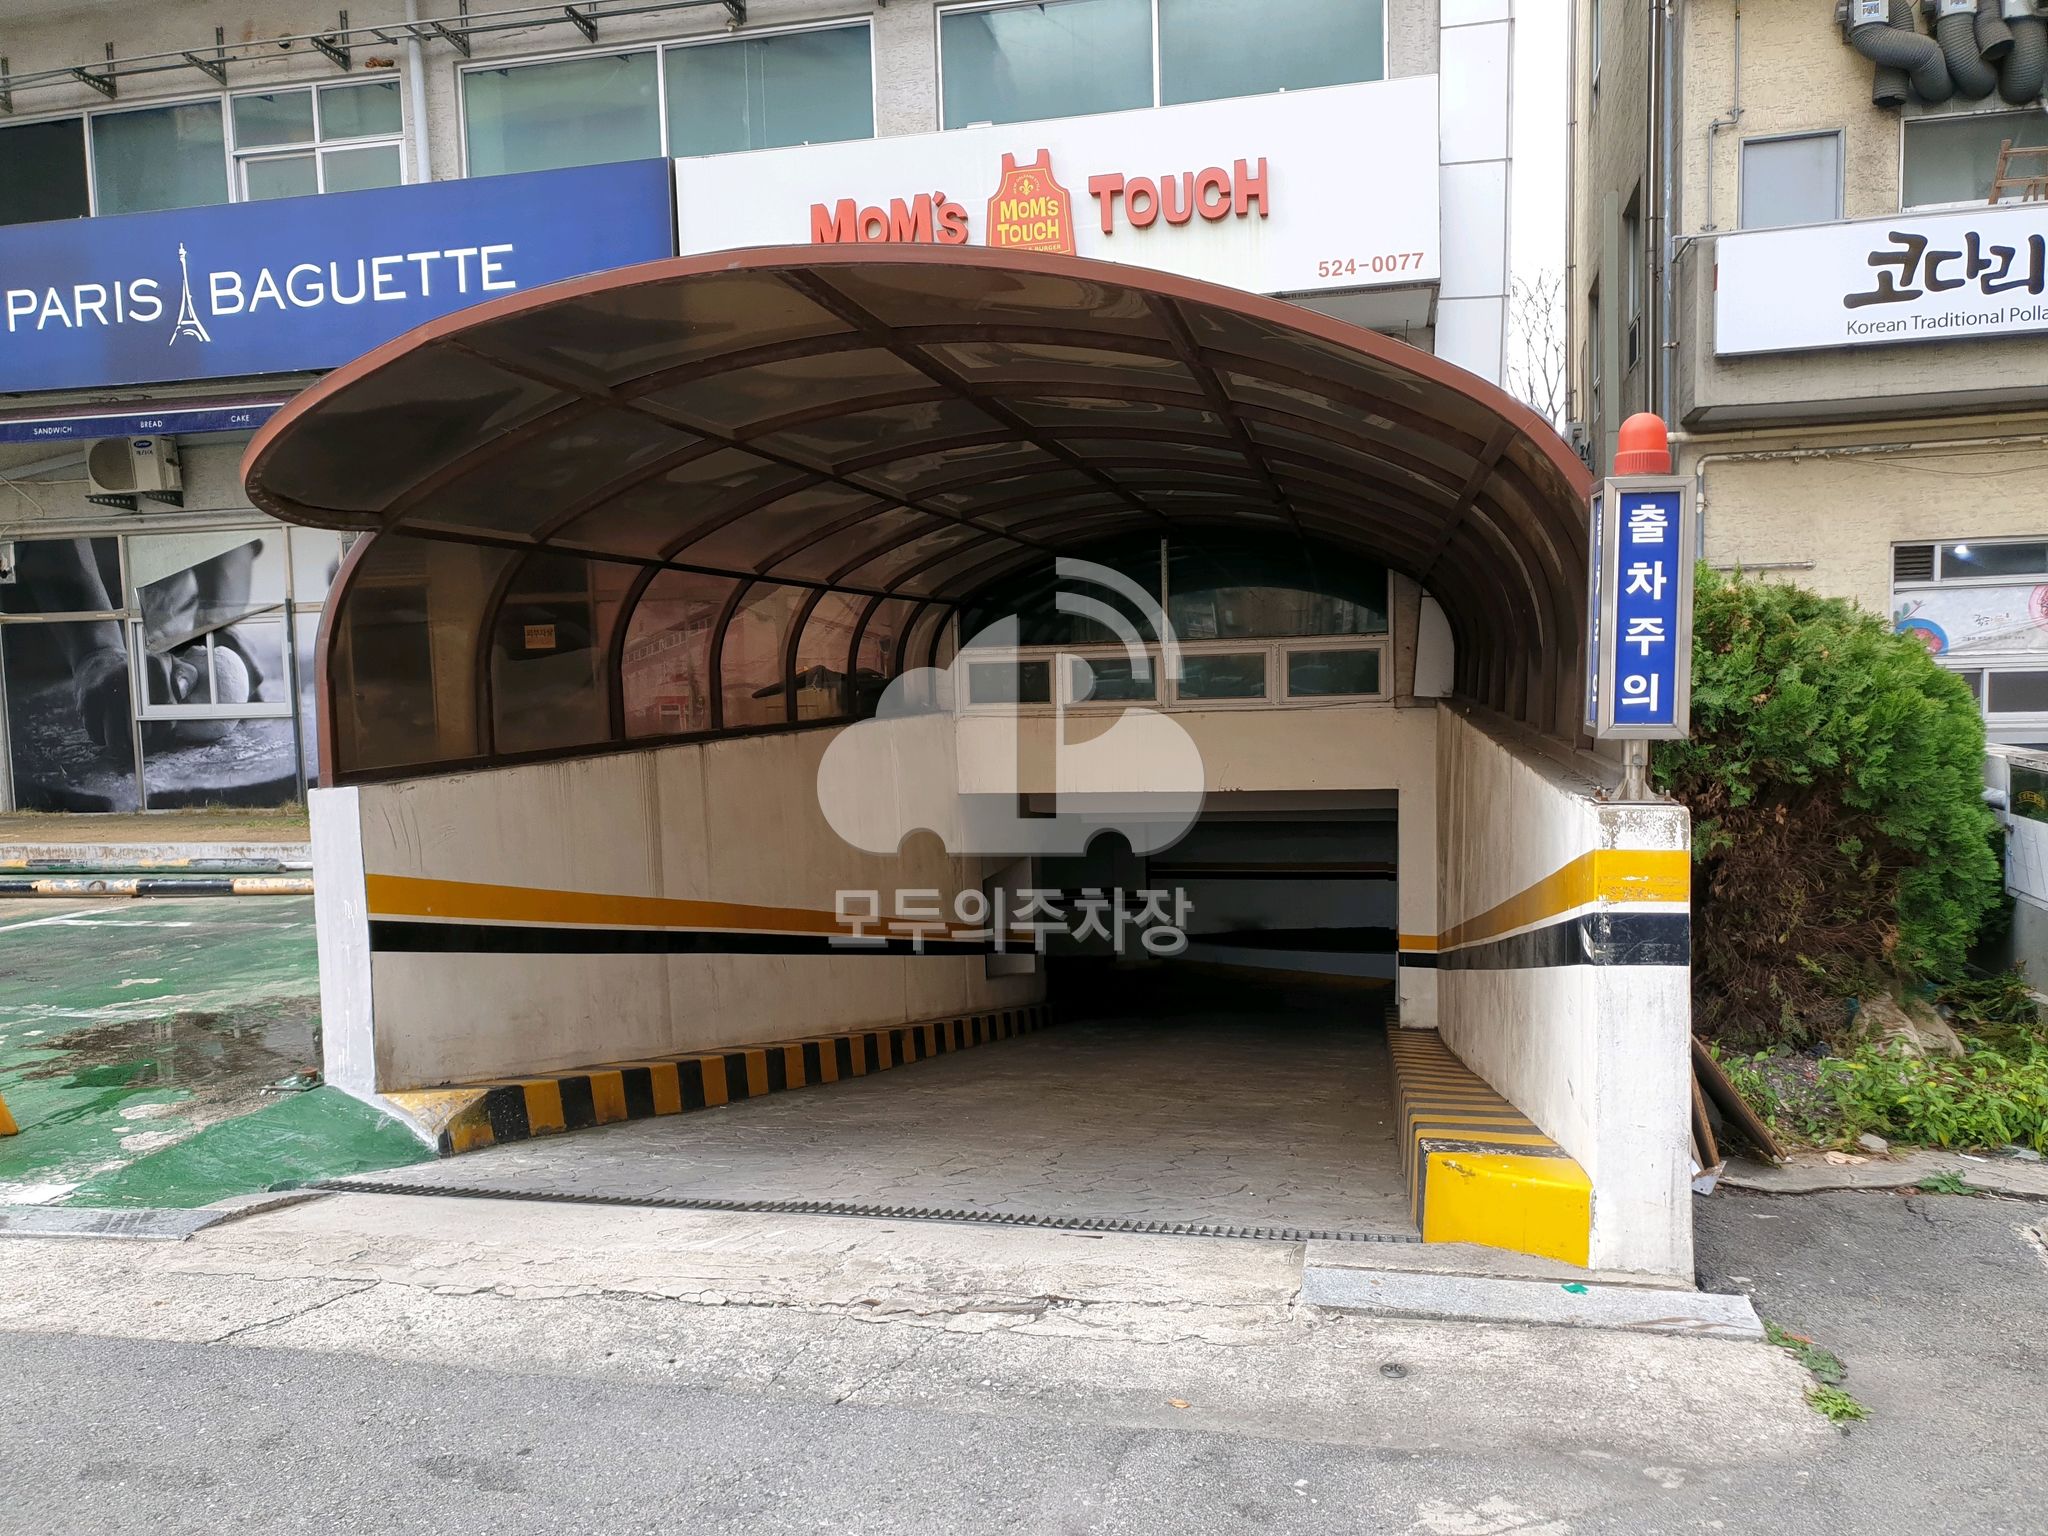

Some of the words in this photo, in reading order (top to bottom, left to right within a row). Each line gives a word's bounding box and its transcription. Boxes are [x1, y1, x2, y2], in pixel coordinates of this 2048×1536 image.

[1088, 157, 1268, 235] TOUCH
[997, 218, 1059, 245] TOUCH
[1318, 252, 1425, 278] 524-0077
[1843, 231, 2045, 309] 코다리
[7, 279, 163, 333] PARIS
[209, 243, 517, 317] BAGUETTE
[1846, 319, 1908, 336] Korean
[1911, 307, 2004, 331] Traditional
[33, 426, 72, 436] SANDWICH
[140, 420, 163, 429] BREAD
[231, 414, 250, 423] CAKE
[1621, 503, 1668, 712] 출차주의
